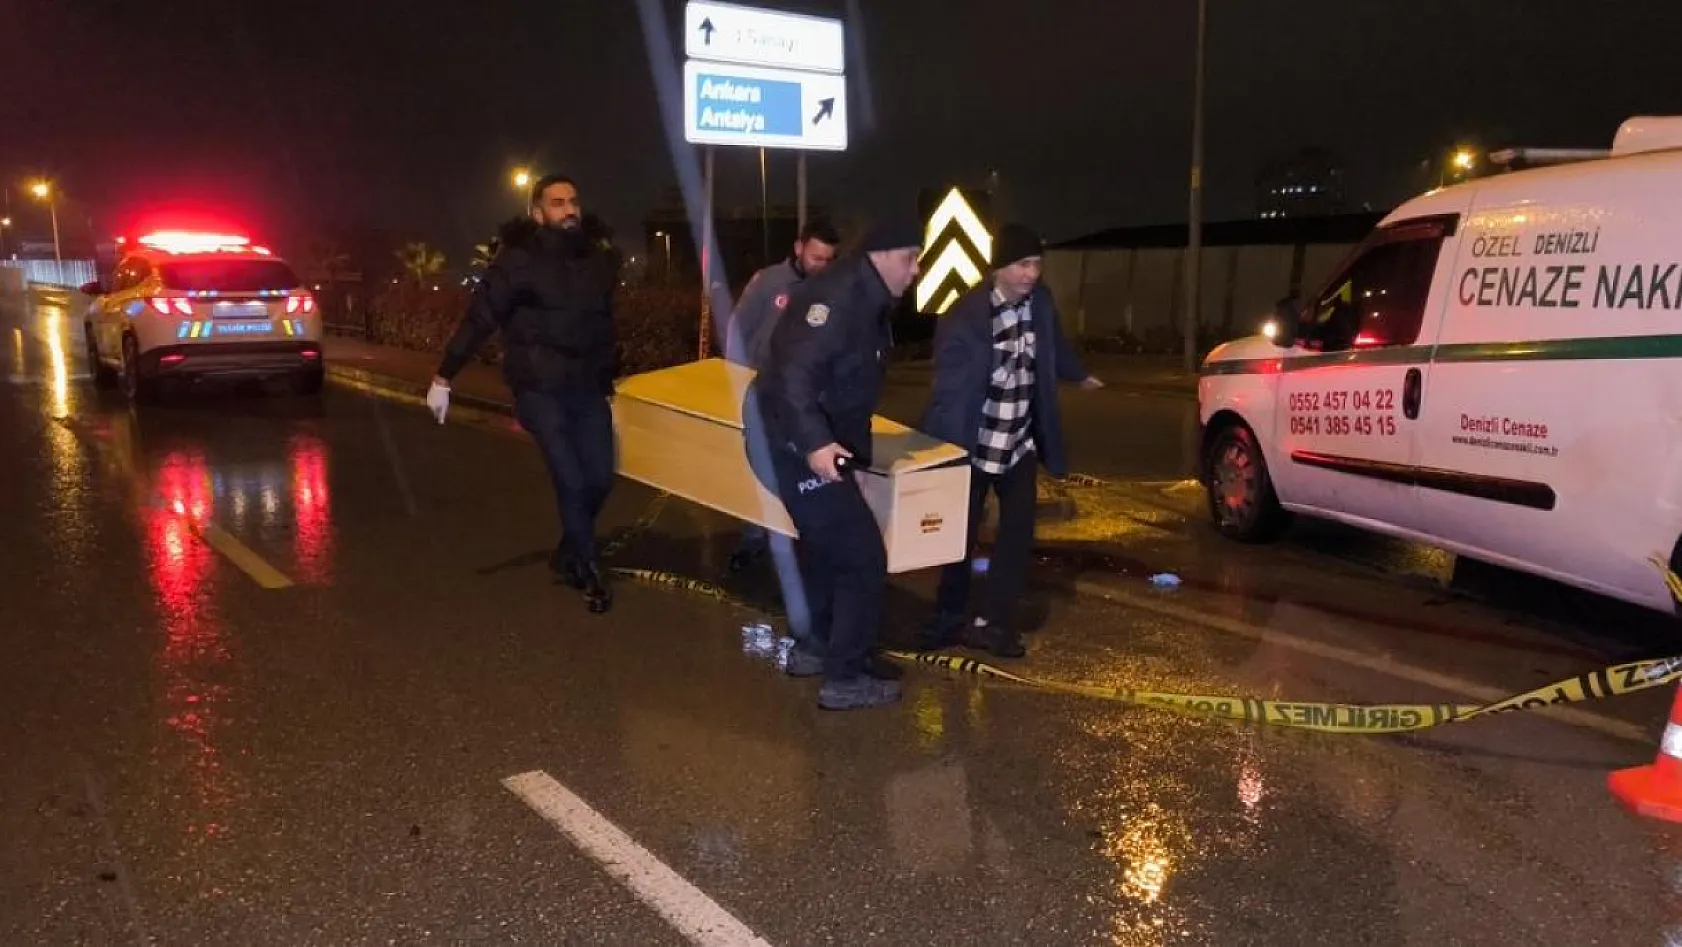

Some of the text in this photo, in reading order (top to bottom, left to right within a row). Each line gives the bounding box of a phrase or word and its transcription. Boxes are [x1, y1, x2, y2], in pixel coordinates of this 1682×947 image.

[700, 77, 762, 103] Ankara
[700, 105, 765, 134] Antalya
[1472, 227, 1600, 258] ÖZEL DENİZLİ
[1459, 265, 1586, 307] CENAZE
[1289, 389, 1395, 411] 0552 457 04 22
[1291, 415, 1396, 435] 0541 385 45 15
[1461, 413, 1548, 439] Denizli Cenaze
